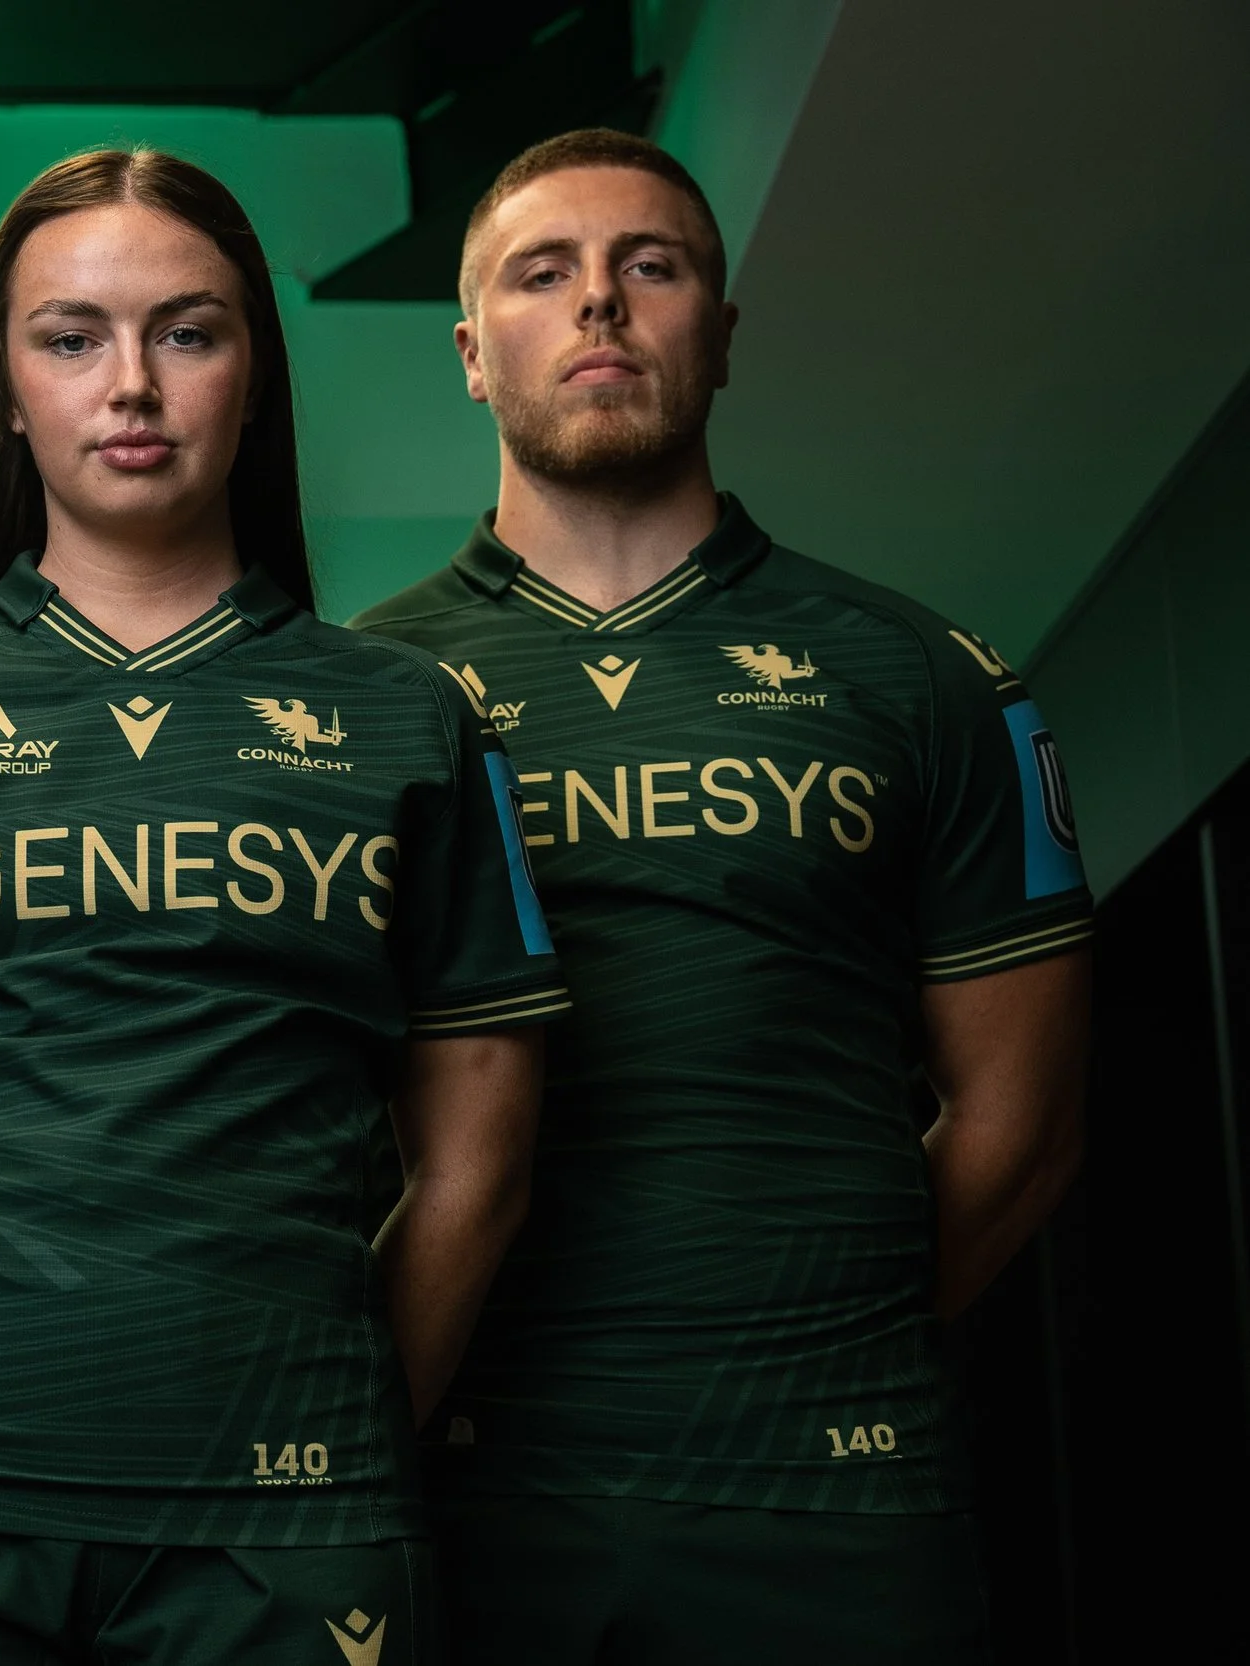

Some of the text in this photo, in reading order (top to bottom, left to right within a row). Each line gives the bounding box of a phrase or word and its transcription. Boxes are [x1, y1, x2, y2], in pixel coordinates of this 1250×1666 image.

[716, 692, 828, 708] CONNACHT
[237, 748, 354, 772] CONNACHT
[279, 764, 313, 773] RUGBY
[826, 1423, 896, 1457] 140
[253, 1442, 329, 1476] 140
